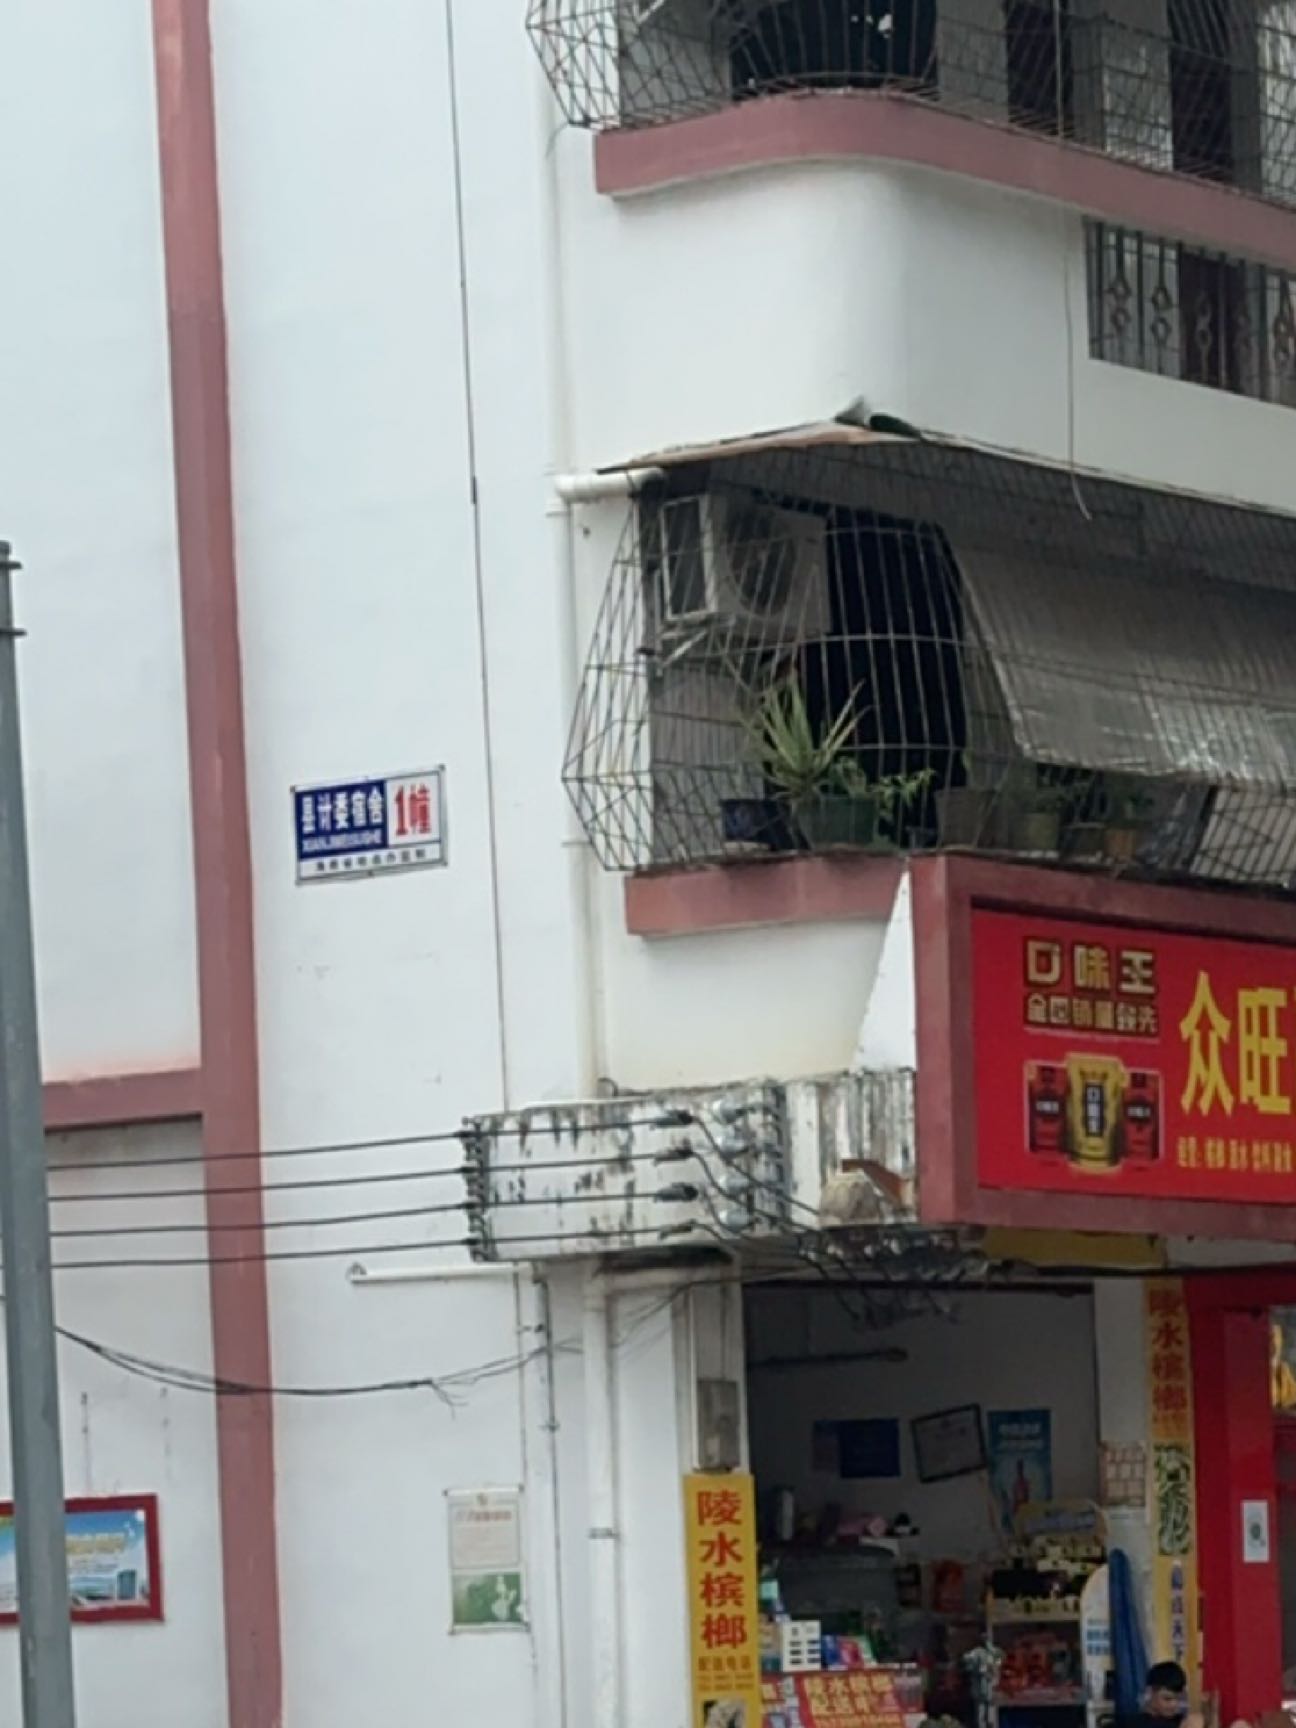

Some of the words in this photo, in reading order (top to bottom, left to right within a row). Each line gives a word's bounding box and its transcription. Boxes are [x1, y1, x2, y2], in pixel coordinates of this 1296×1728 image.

[1027, 940, 1156, 994] 口味王
[696, 1490, 748, 1650] 陵水槟榔
